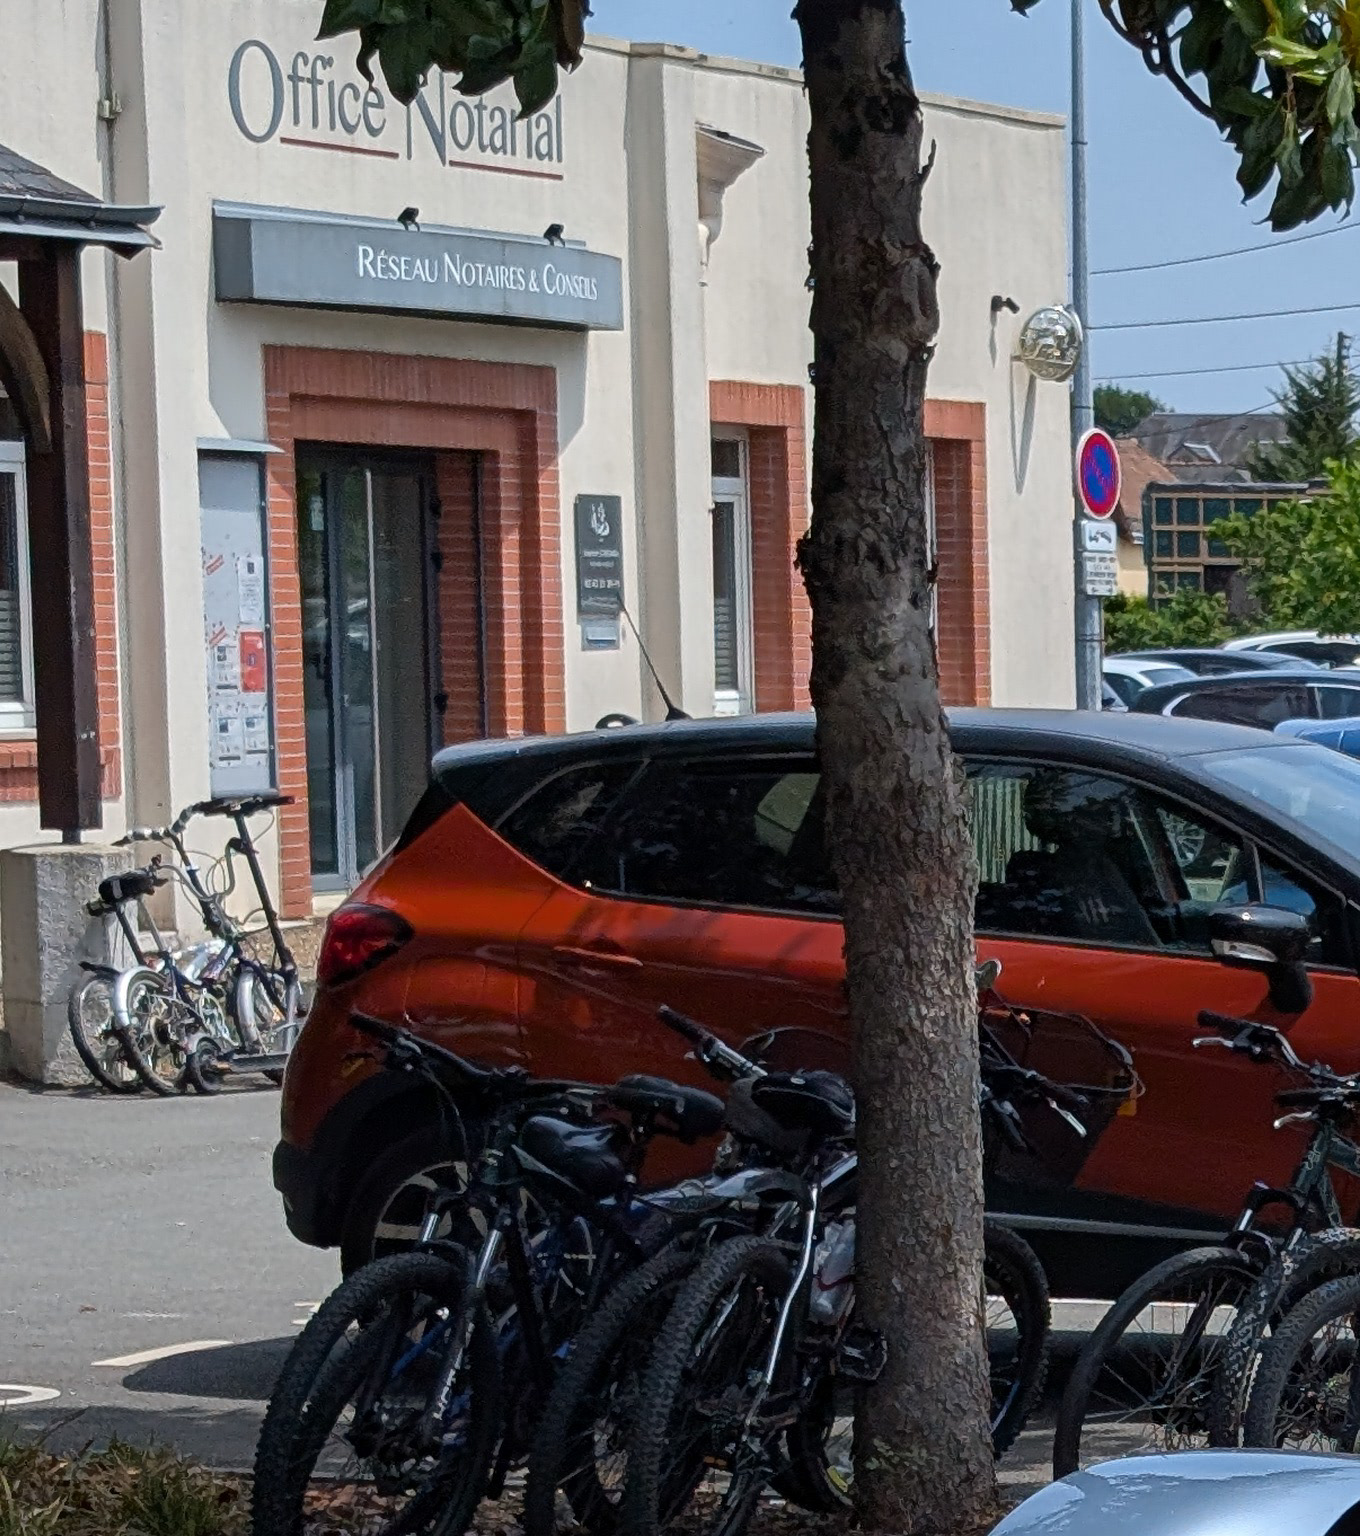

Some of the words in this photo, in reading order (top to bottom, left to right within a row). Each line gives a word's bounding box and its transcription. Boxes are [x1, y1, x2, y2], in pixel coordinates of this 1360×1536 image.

[228, 39, 386, 143] Office
[444, 251, 526, 292] NOTAIRES
[528, 268, 540, 292] &
